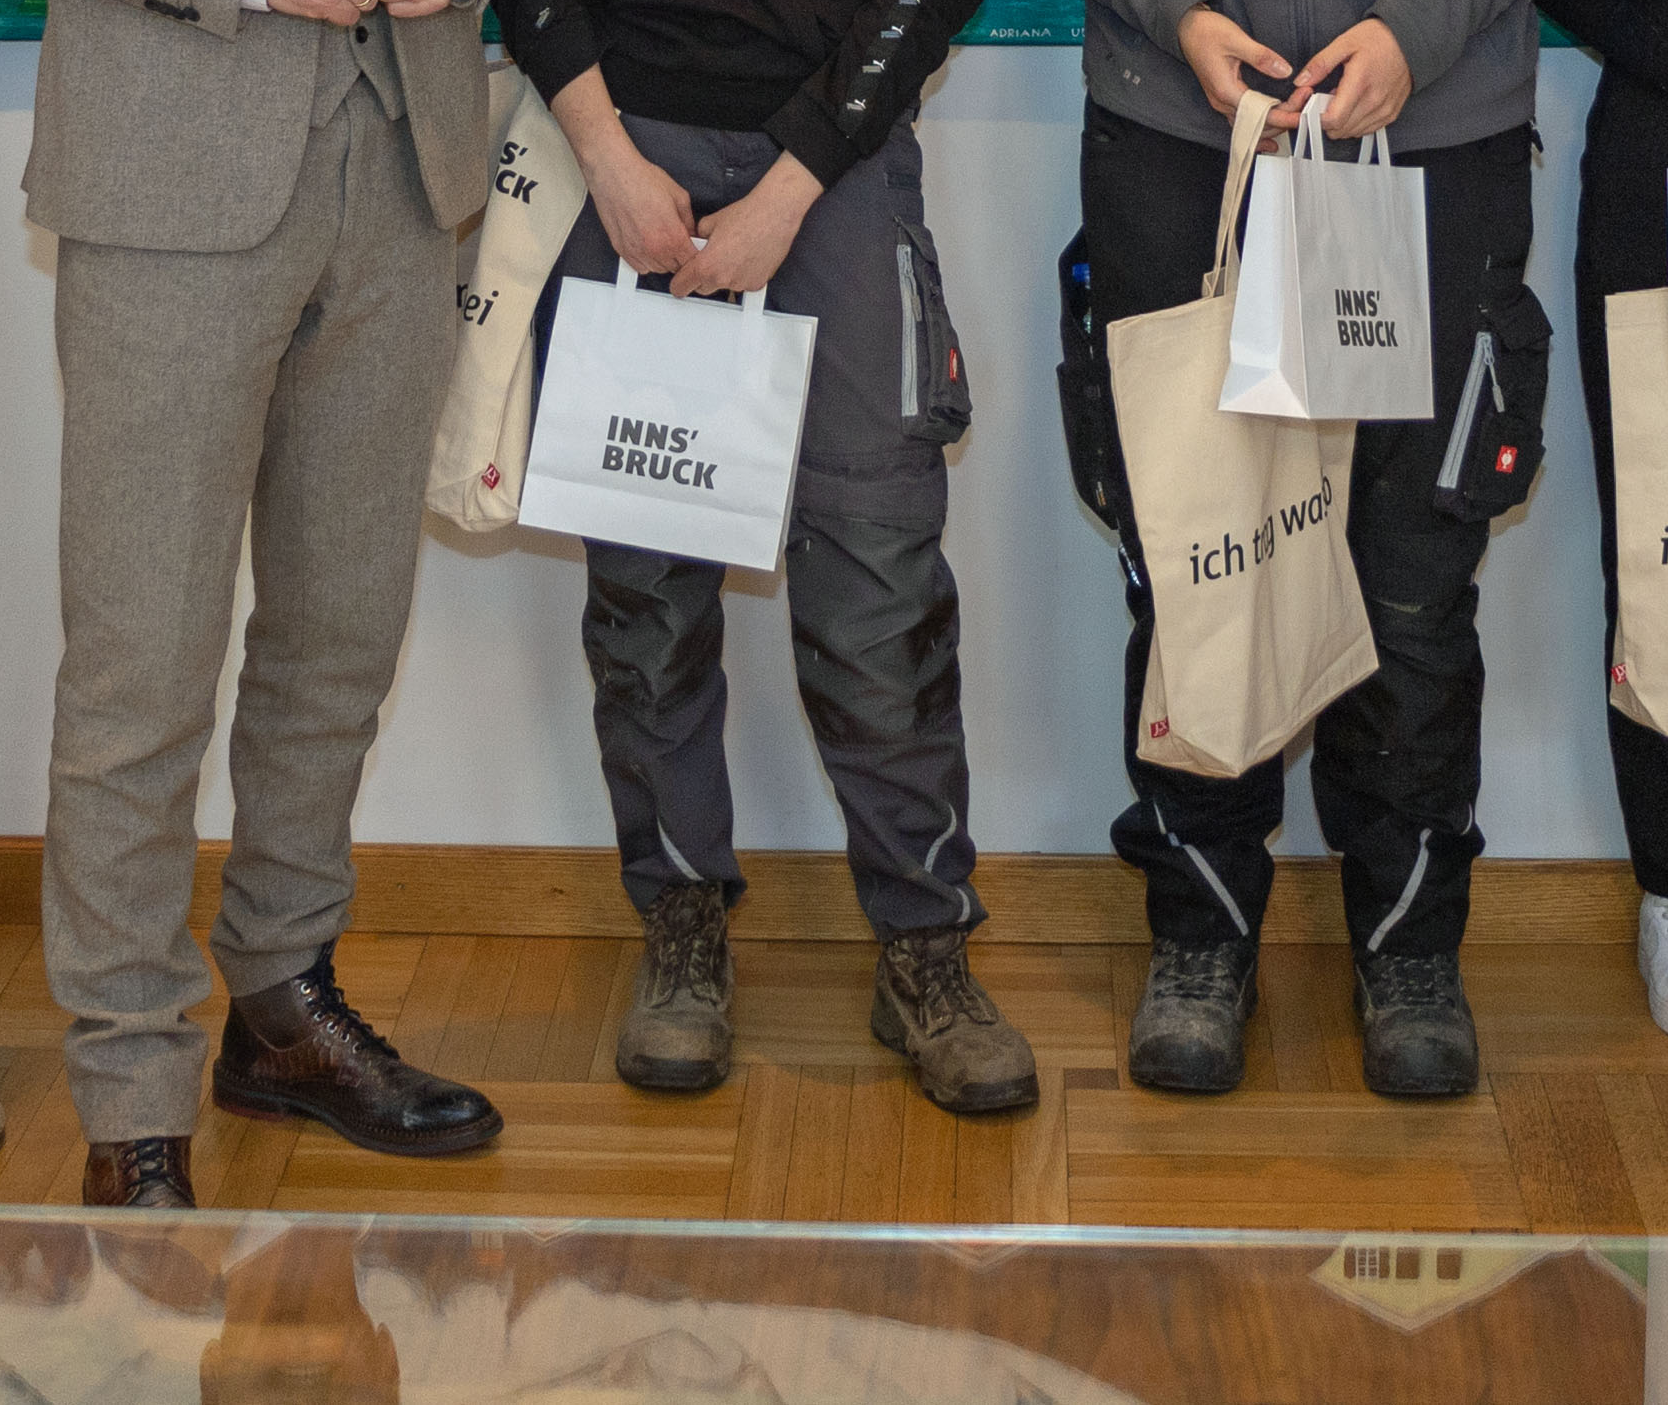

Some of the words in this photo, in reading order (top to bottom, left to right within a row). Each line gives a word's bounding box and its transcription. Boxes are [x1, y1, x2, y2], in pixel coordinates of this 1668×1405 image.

[989, 27, 1052, 38] ADRIANA
[1334, 288, 1380, 317] INNS'
[1337, 319, 1399, 347] BRUCK
[606, 415, 700, 453] INNS'
[601, 444, 719, 490] BRUCK
[1189, 532, 1245, 585] ich
